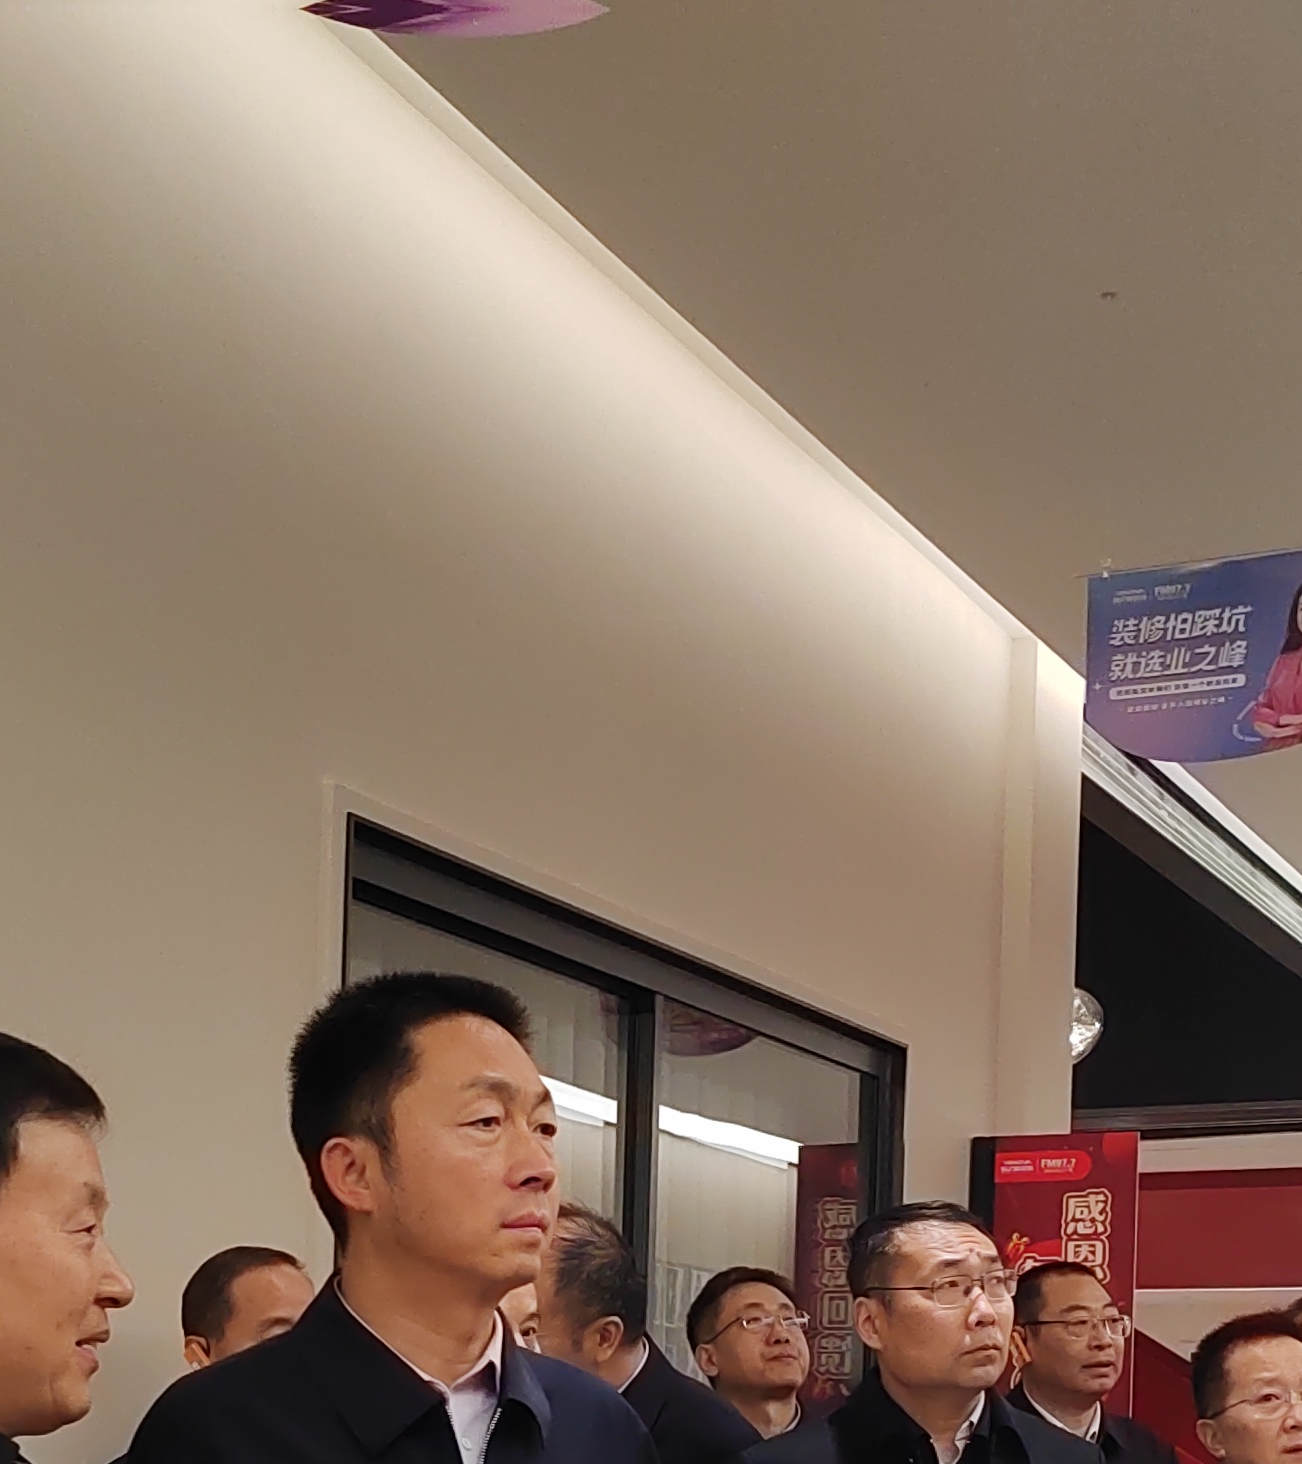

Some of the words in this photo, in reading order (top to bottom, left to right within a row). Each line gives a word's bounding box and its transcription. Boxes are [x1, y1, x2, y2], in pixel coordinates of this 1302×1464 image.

[1109, 605, 1252, 646] 装修怕踩坑
[1109, 640, 1248, 681] 就选业之峰
